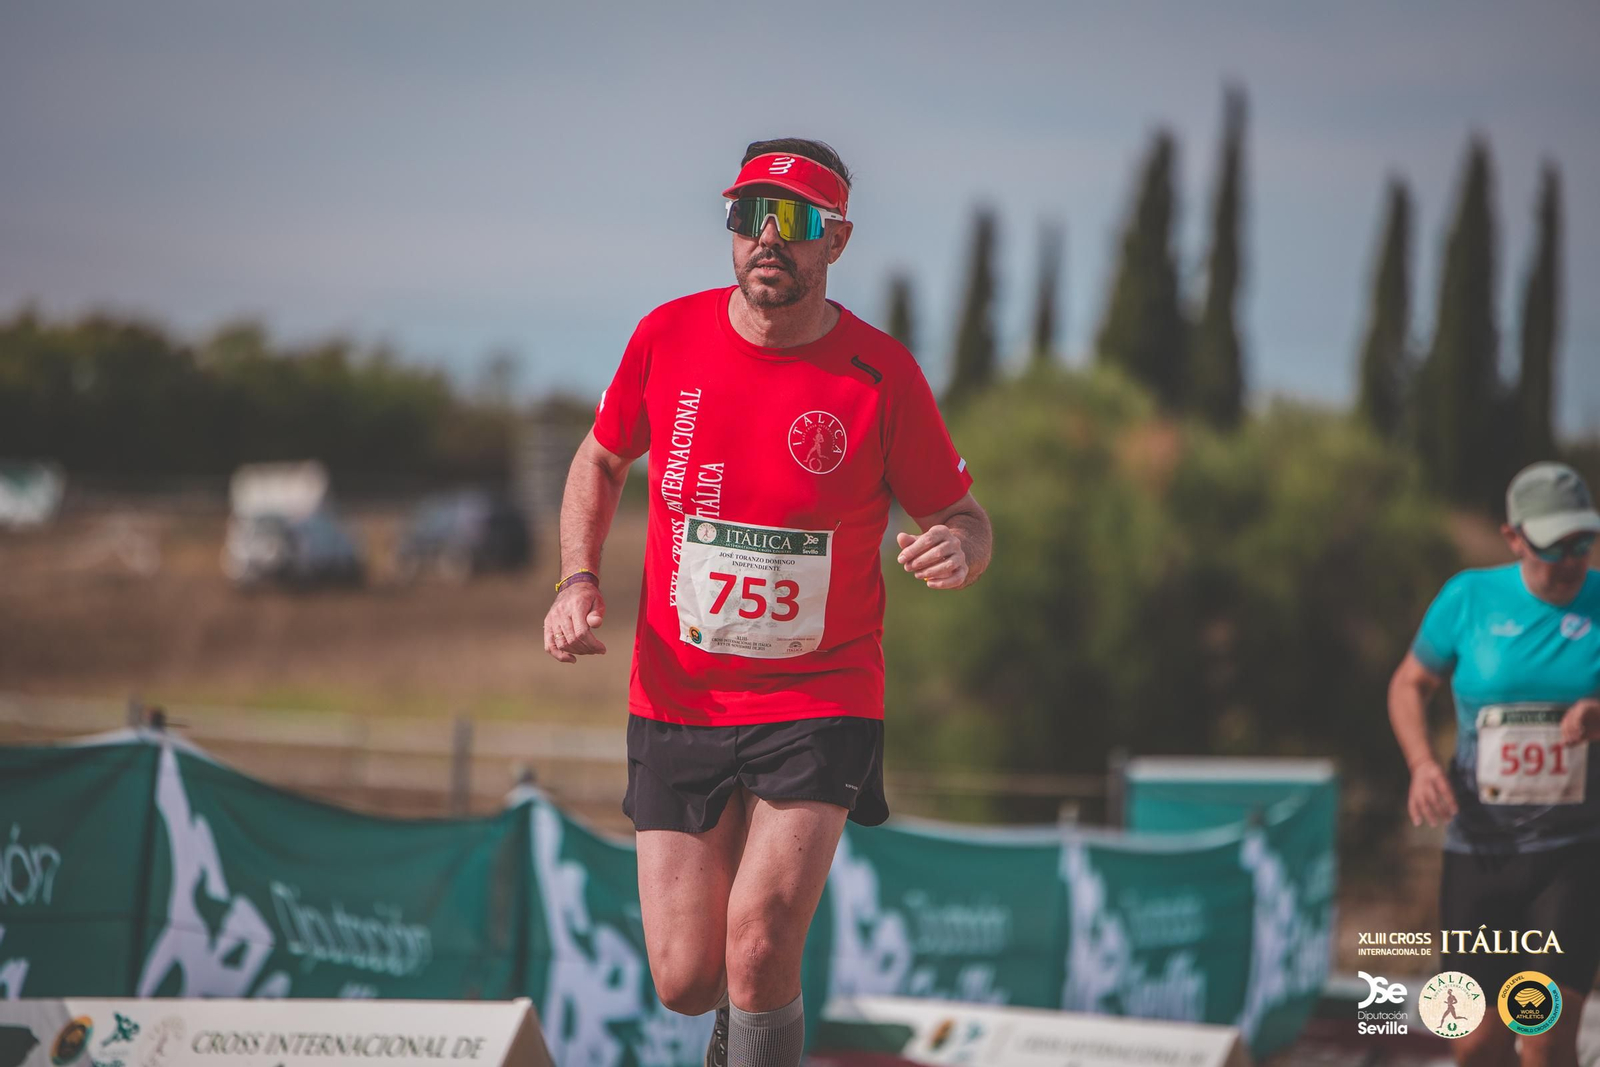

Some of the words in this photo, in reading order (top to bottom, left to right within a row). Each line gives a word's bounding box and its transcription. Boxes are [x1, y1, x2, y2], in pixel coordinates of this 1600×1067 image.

[661, 387, 702, 515] INTERNACIONAL
[690, 462, 725, 519] TÁLICA
[725, 529, 792, 550] ITÁLICA
[719, 552, 734, 561] JOSÉ
[735, 554, 765, 564] TORANZO
[765, 557, 796, 566] DOMINGO
[732, 560, 781, 572] INDEPENDIENTE
[709, 571, 800, 622] 753
[1500, 742, 1567, 776] 591
[264, 1031, 449, 1061] INTERNACIONAL
[452, 1036, 486, 1062] DE
